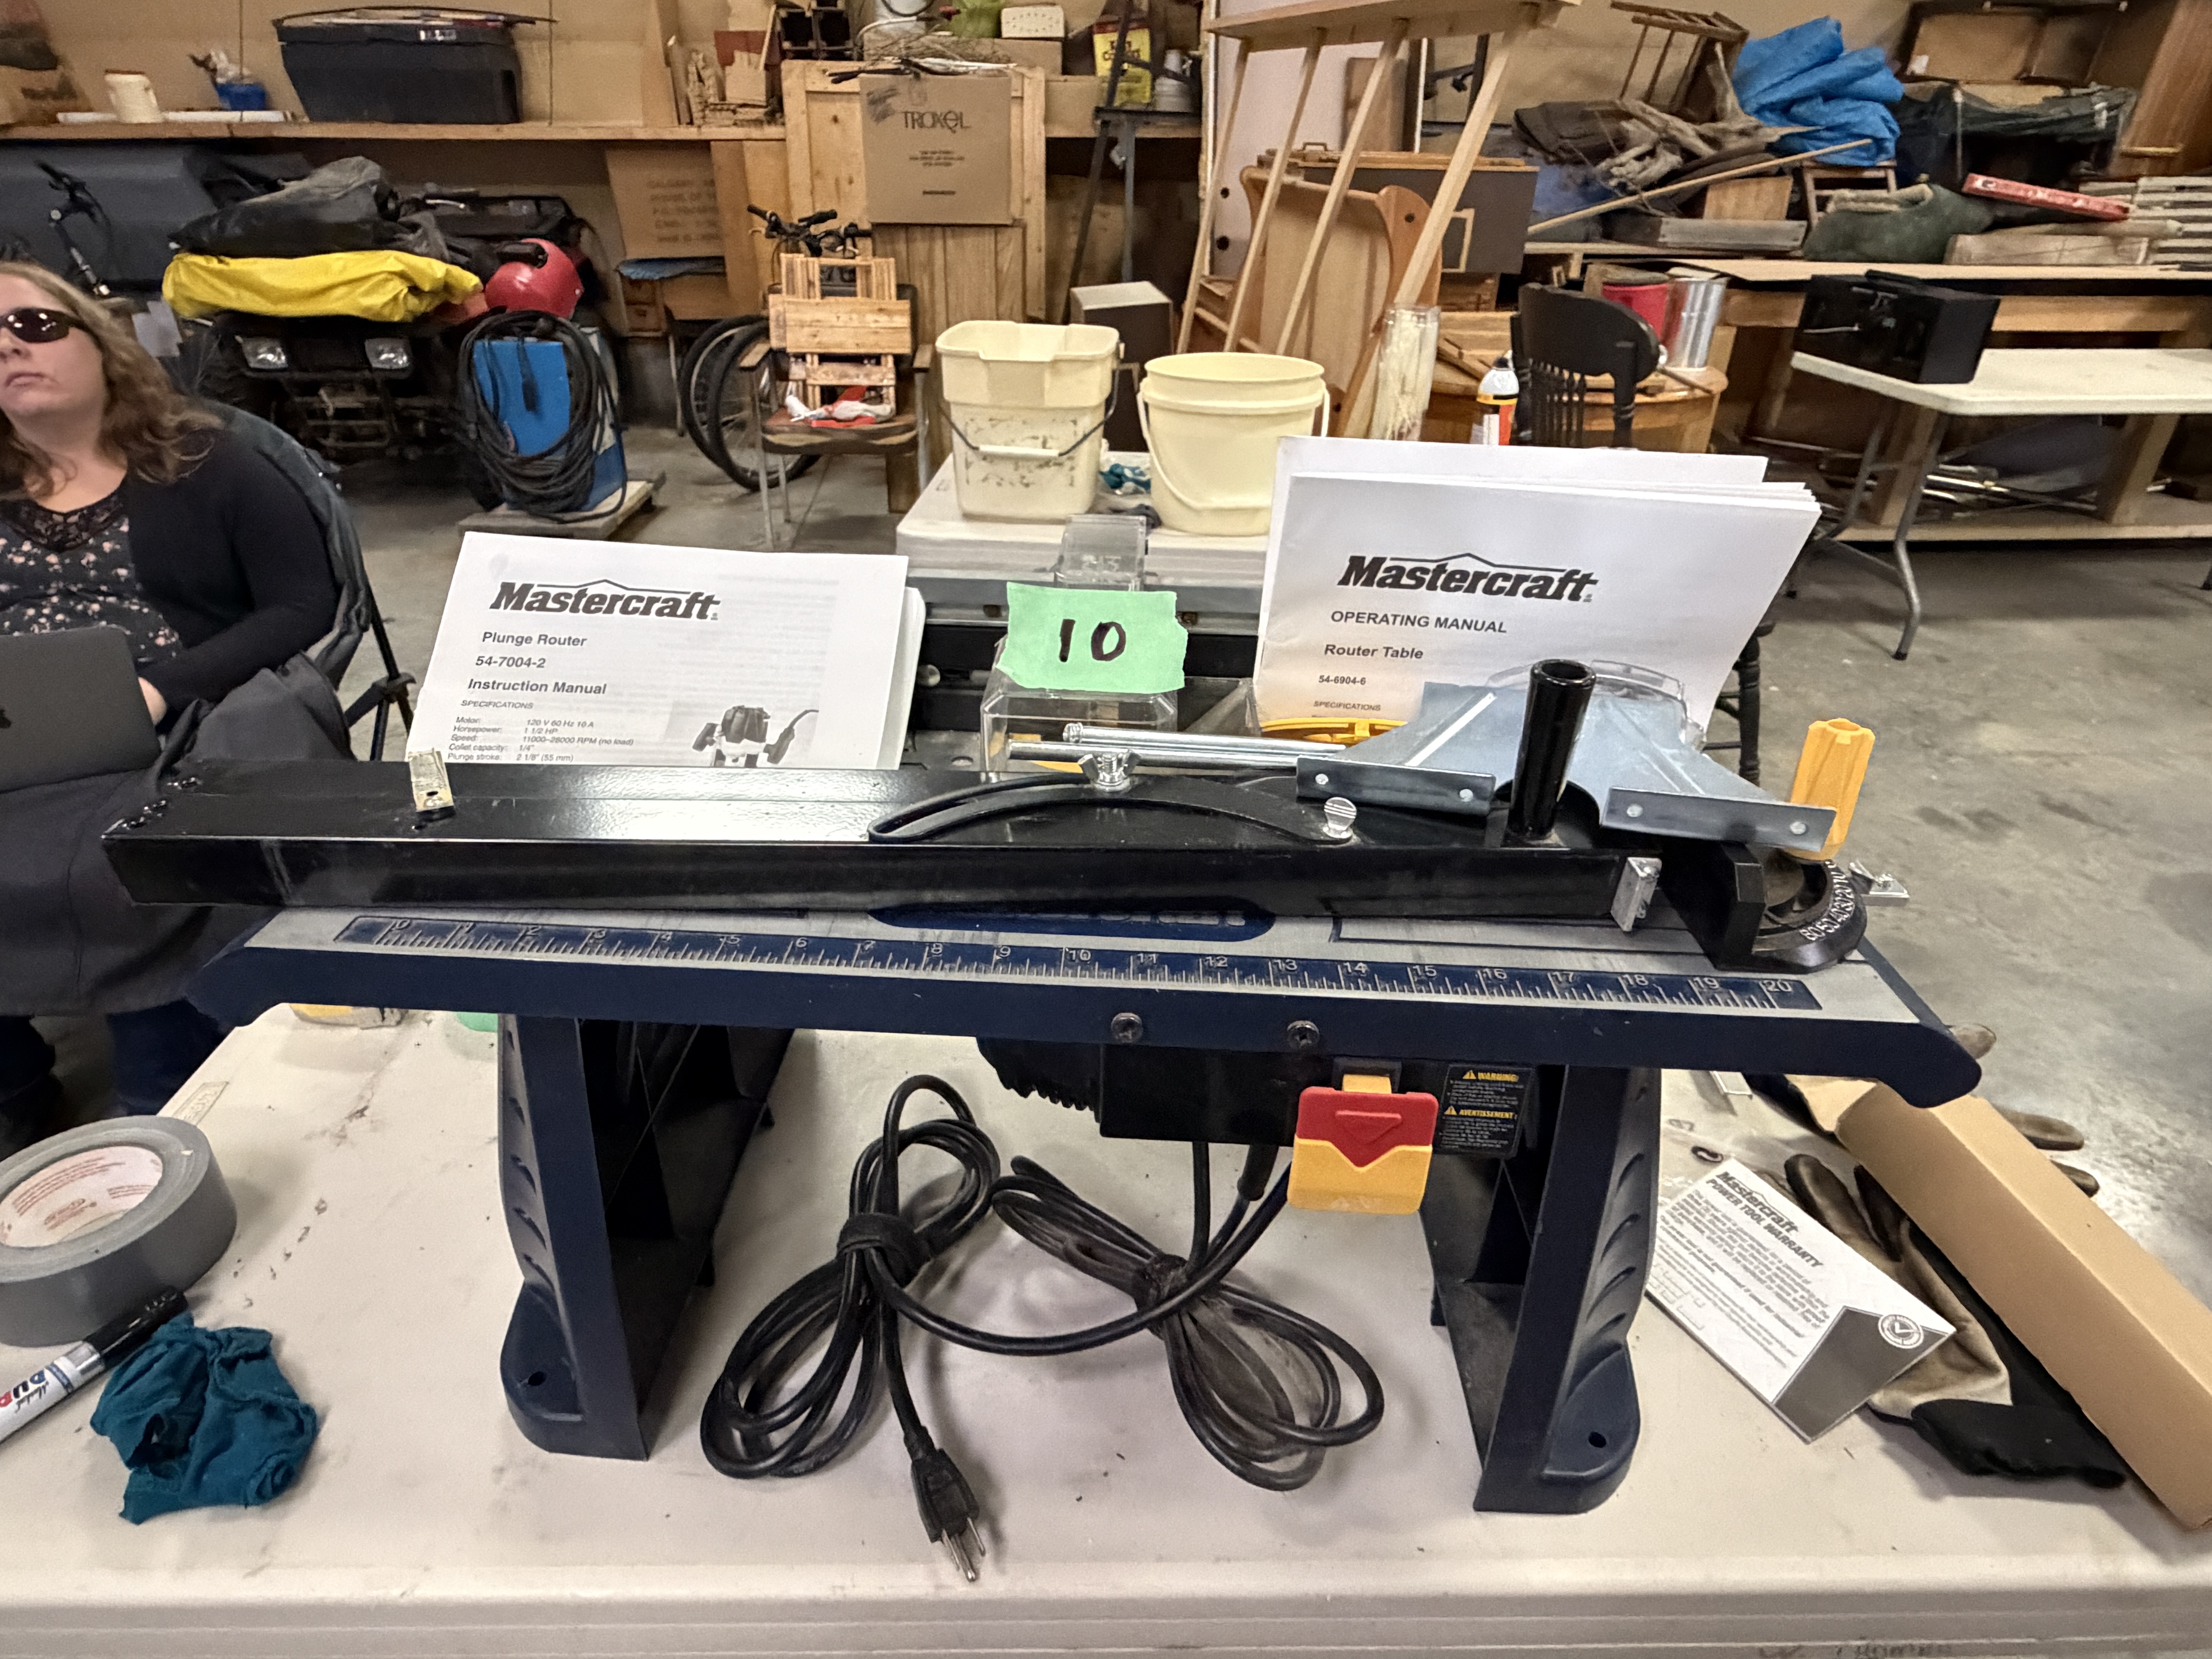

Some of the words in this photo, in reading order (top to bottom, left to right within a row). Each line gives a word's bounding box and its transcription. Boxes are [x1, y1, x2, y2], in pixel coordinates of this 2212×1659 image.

[1337, 554, 1599, 602] Mastercraft
[489, 580, 721, 620] Mastercraft
[1331, 610, 1429, 627] OPERATING
[1434, 617, 1507, 633] MANUAL
[483, 632, 533, 646] Plunge
[538, 635, 587, 646] Router
[1059, 619, 1126, 662] 10
[1324, 644, 1378, 657] Router
[1383, 647, 1424, 659] Table
[476, 656, 546, 668] 54-7004-2
[468, 679, 548, 692] Instruction
[553, 682, 606, 694] Manual
[1318, 675, 1366, 685] 54-6904-6
[460, 700, 534, 709] SPECIFICATIONS
[1313, 700, 1381, 711] SPECIFICATIONS
[448, 753, 474, 761] Plunge
[727, 934, 740, 944] 5
[796, 937, 808, 948] 6
[931, 943, 943, 955] 8
[1000, 946, 1012, 958] 9
[1069, 949, 1091, 961] 10
[1137, 953, 1157, 963] 11
[1205, 957, 1228, 968] 12
[1274, 959, 1297, 970] 13
[1345, 962, 1368, 974] 14
[1413, 965, 1437, 977] 15
[1483, 968, 1507, 979] 16
[1552, 971, 1575, 983] 17
[1625, 974, 1649, 986] 18
[1693, 977, 1721, 989] 19
[1763, 980, 1791, 992] 20
[1716, 1171, 1798, 1234] Mastercraft
[1706, 1179, 1743, 1206] POWER
[1740, 1204, 1765, 1225] TOOL
[1763, 1223, 1824, 1267] WARRANTY
